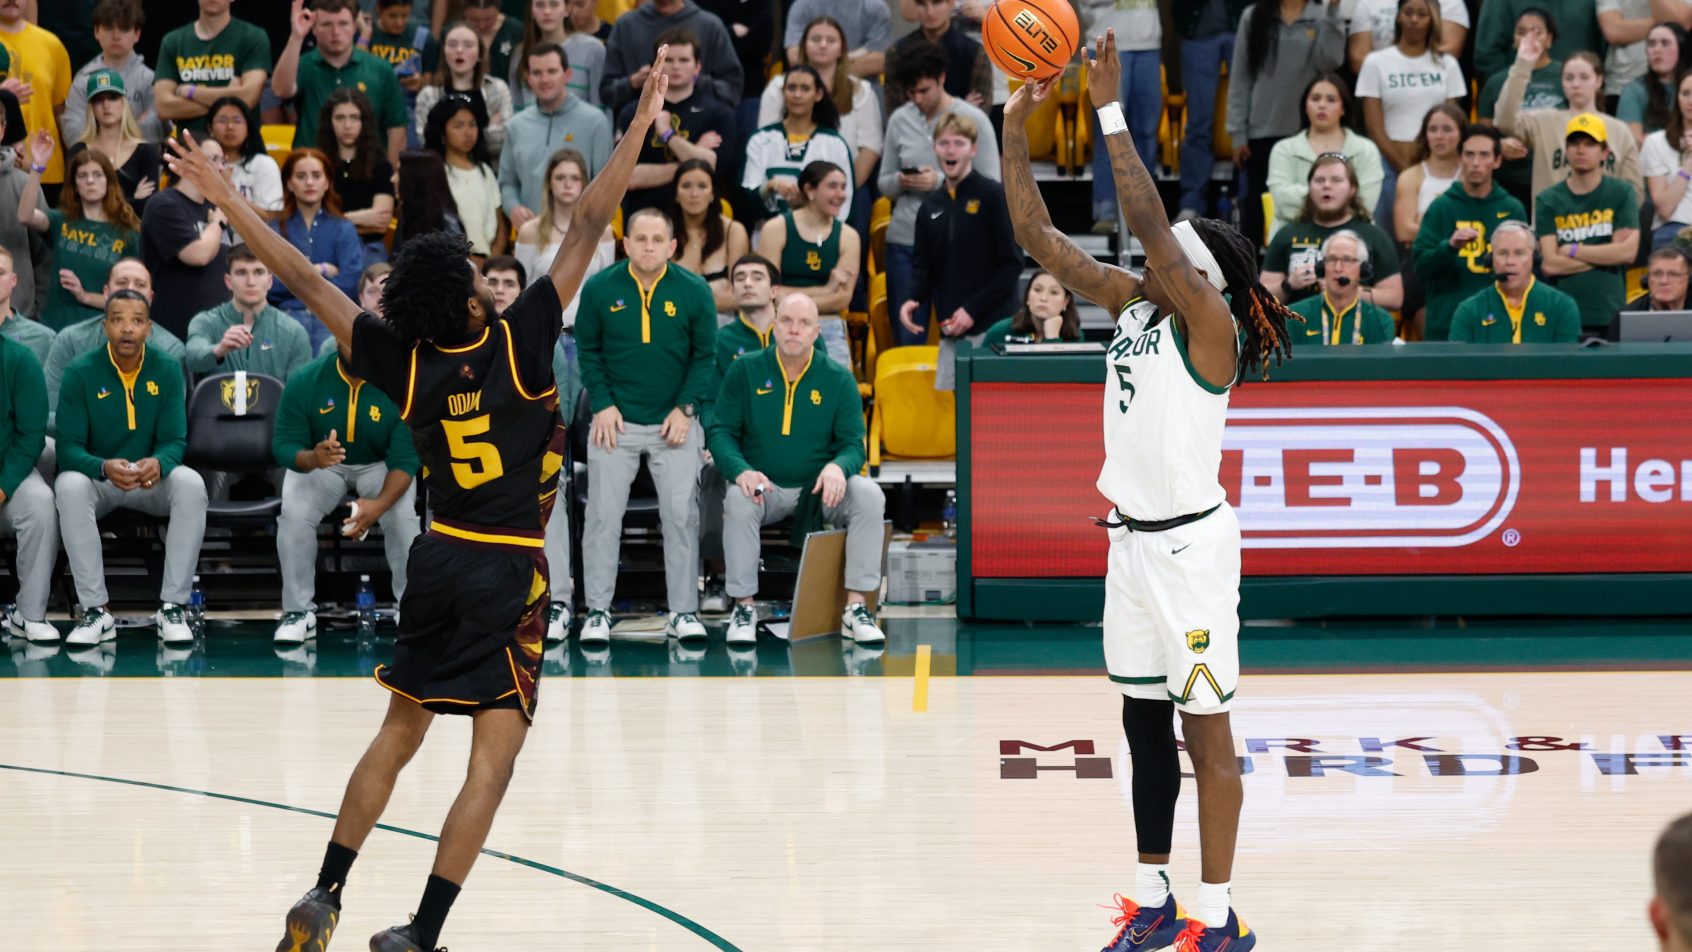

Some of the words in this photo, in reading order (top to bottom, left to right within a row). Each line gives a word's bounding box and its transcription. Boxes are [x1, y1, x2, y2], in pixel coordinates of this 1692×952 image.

[1014, 12, 1059, 55] ELITE
[1114, 364, 1136, 414] 5
[440, 413, 504, 490] 5
[1000, 736, 1447, 755] MRK
